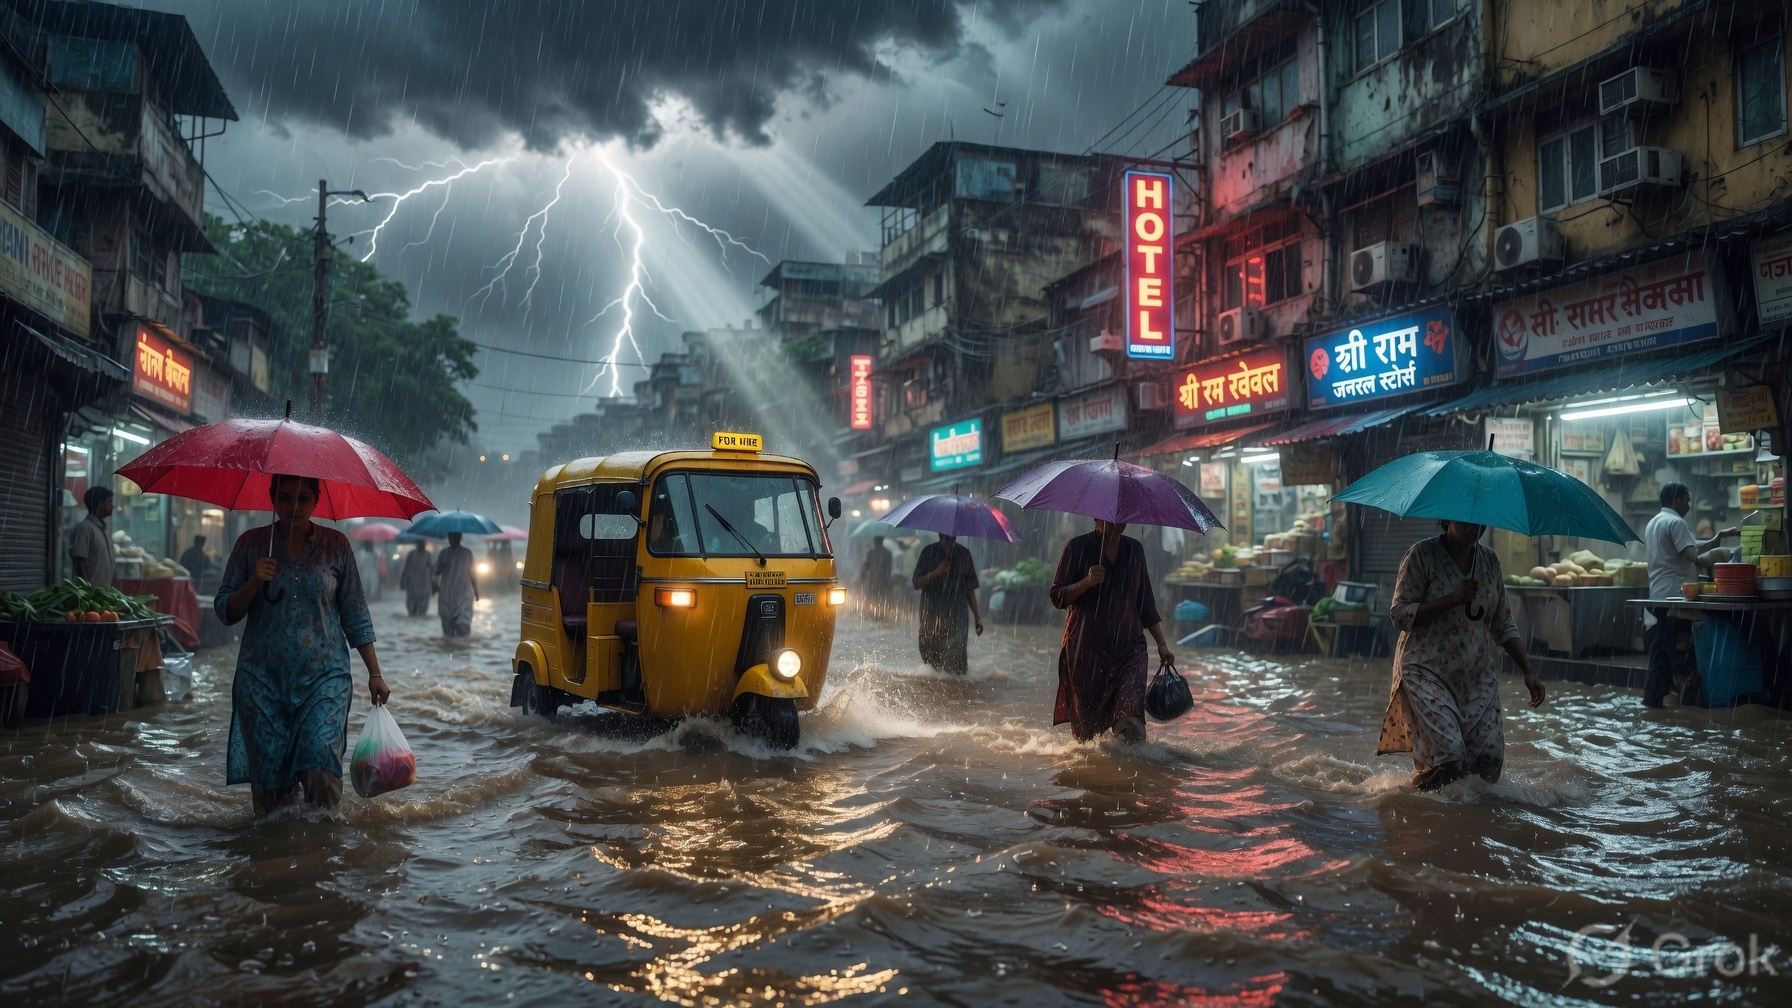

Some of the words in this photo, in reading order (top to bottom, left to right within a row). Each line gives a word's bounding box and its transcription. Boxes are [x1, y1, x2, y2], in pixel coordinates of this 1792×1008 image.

[1135, 180, 1164, 340] HOTEL
[1373, 325, 1419, 365] राम
[1332, 374, 1376, 398] जनरल
[1379, 360, 1417, 391] स्टोर्स
[718, 436, 736, 446] FOR
